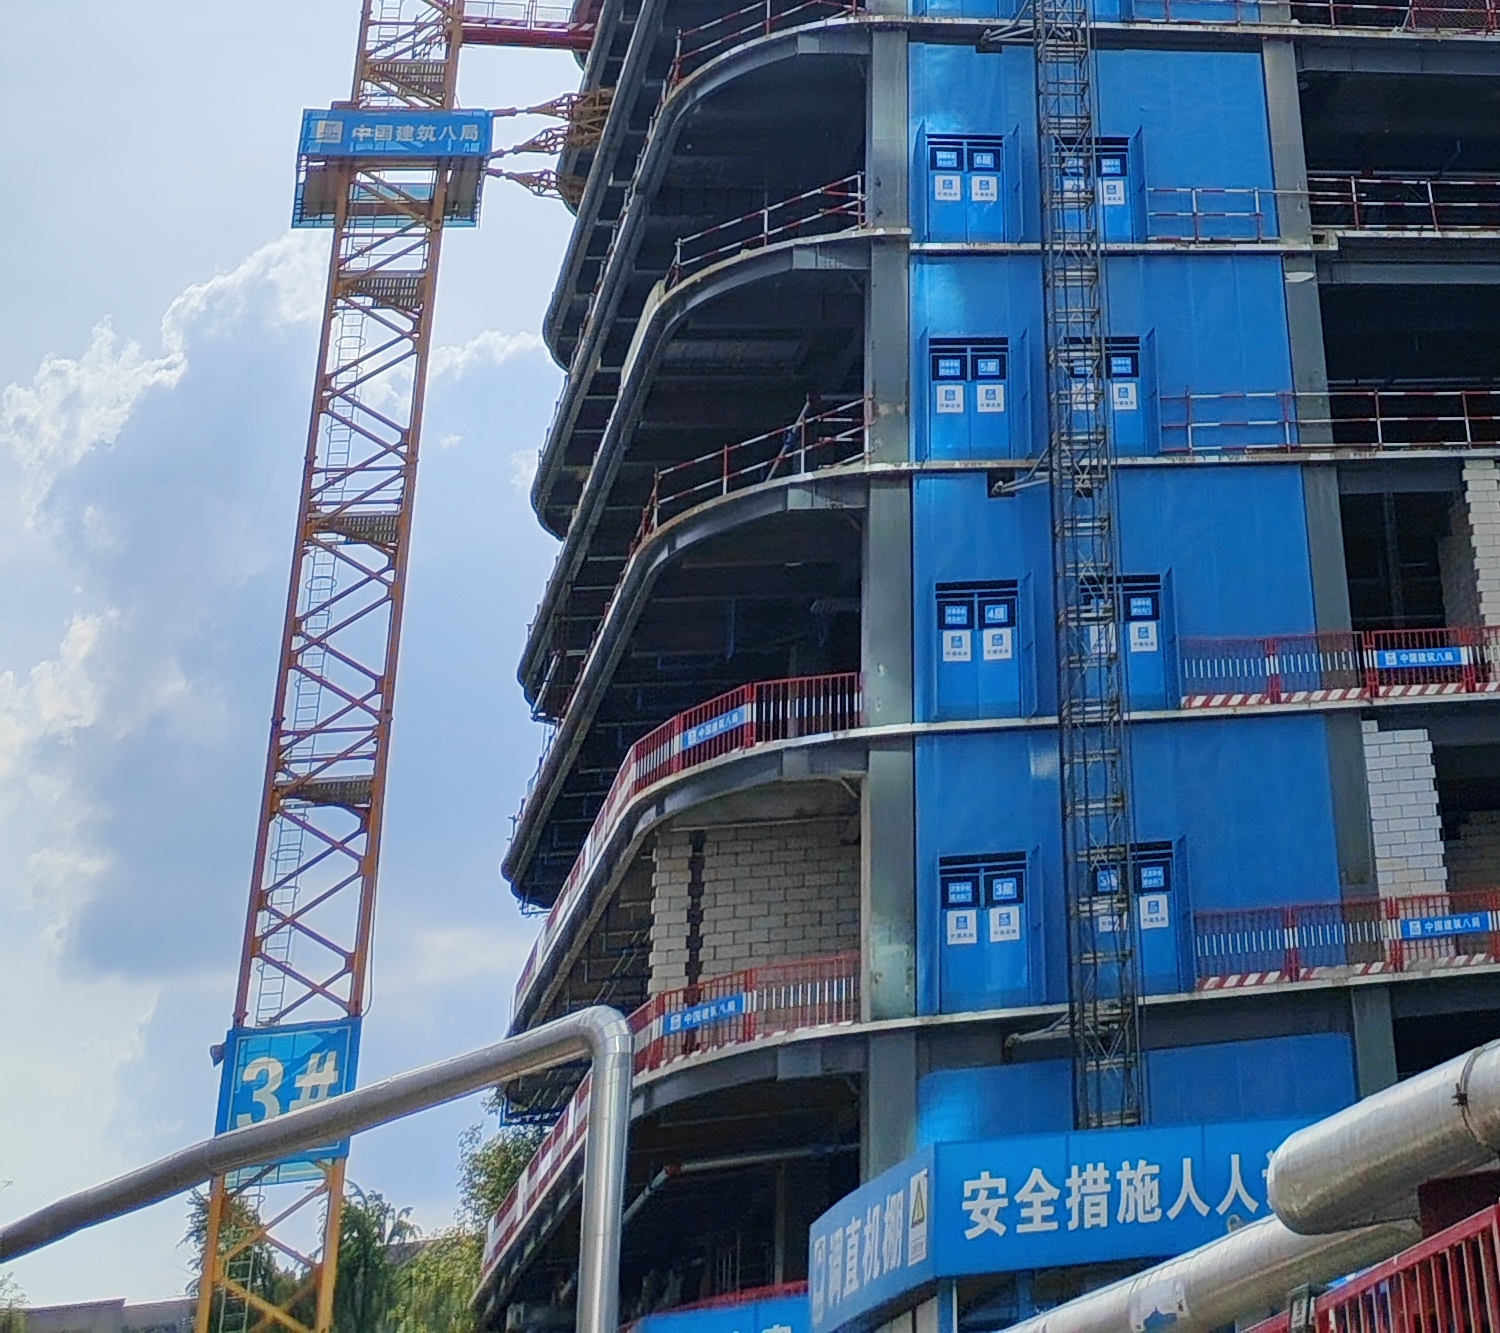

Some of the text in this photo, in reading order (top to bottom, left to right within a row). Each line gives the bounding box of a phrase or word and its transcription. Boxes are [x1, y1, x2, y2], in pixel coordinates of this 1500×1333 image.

[352, 124, 479, 142] 中国建筑八局
[987, 607, 1005, 620] 4层
[1400, 652, 1453, 663] 中国建筑八局
[995, 882, 1014, 896] 3层
[1425, 917, 1481, 932] 中国建筑八局
[236, 1050, 339, 1127] 3#
[962, 1150, 1274, 1239] 安全措施人人
